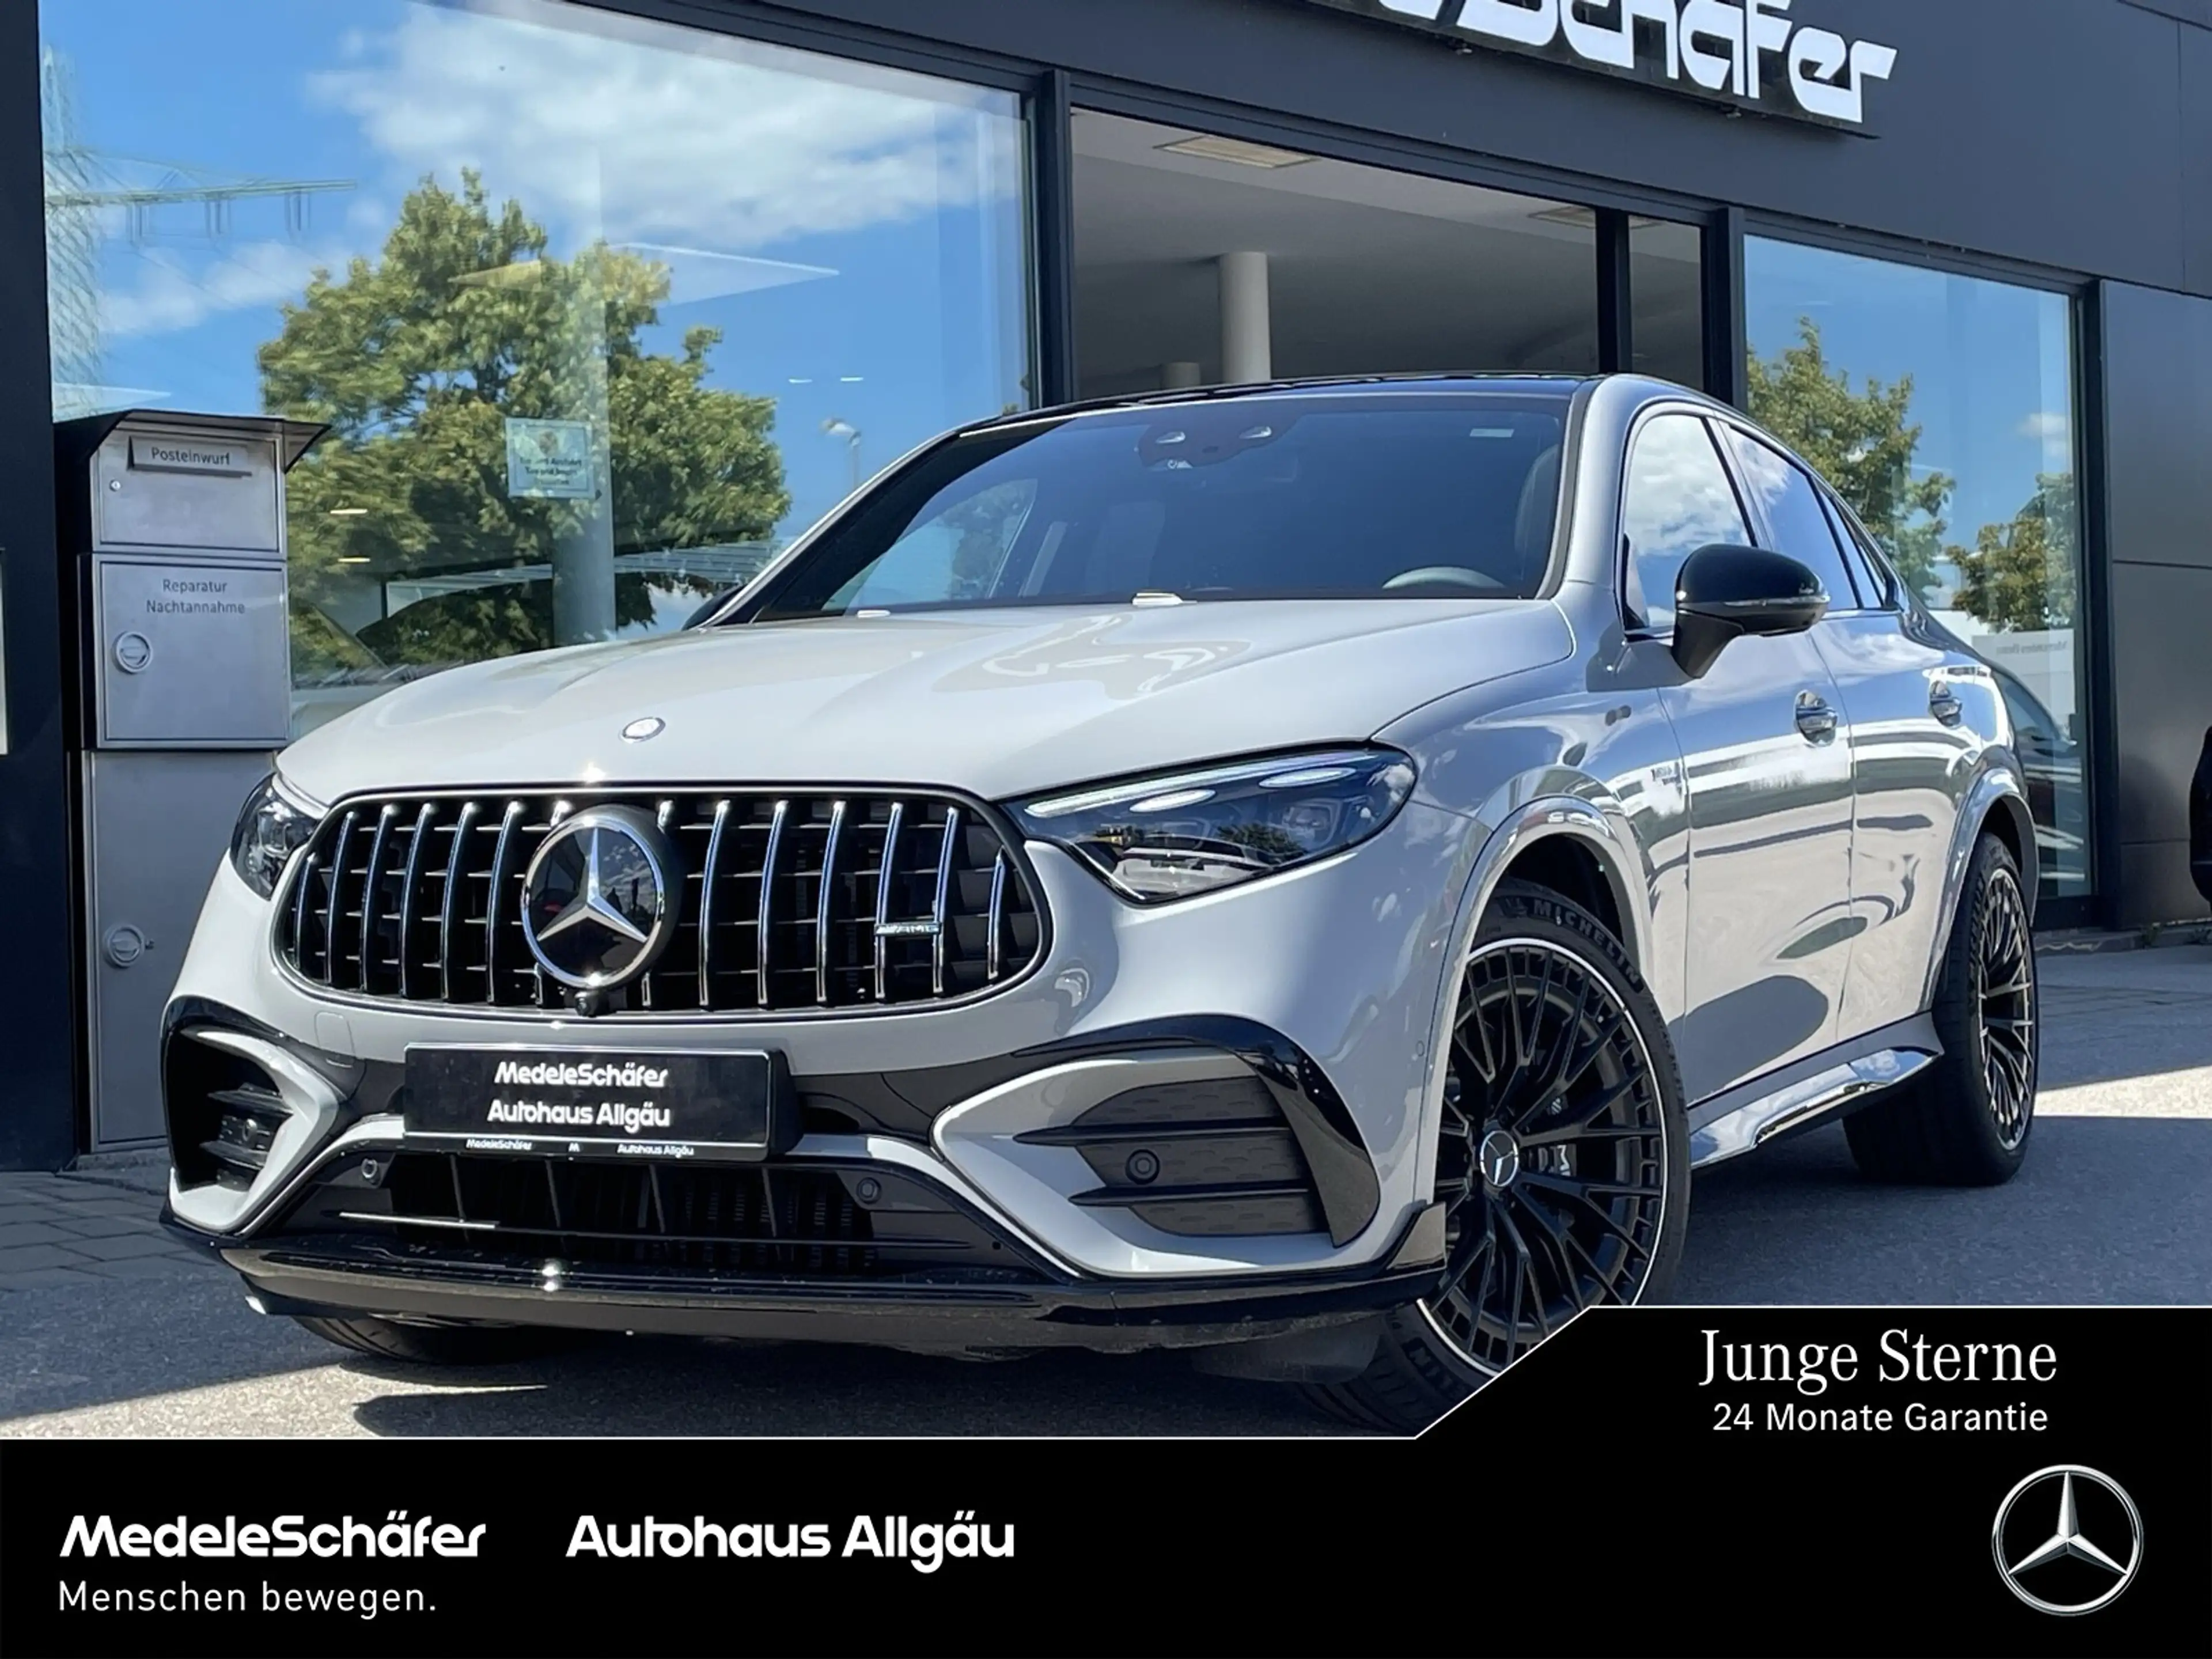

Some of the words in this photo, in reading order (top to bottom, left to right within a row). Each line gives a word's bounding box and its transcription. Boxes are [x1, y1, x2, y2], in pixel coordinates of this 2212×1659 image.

[151, 446, 230, 465] Posteinwurf
[162, 579, 228, 593] Reparatur
[146, 600, 245, 614] Nachtannahme
[1533, 899, 1640, 984] MICHELIN
[494, 1061, 669, 1088] MedeleSchäfer
[487, 1099, 593, 1126] Autohaus
[596, 1101, 671, 1134] Allgäu
